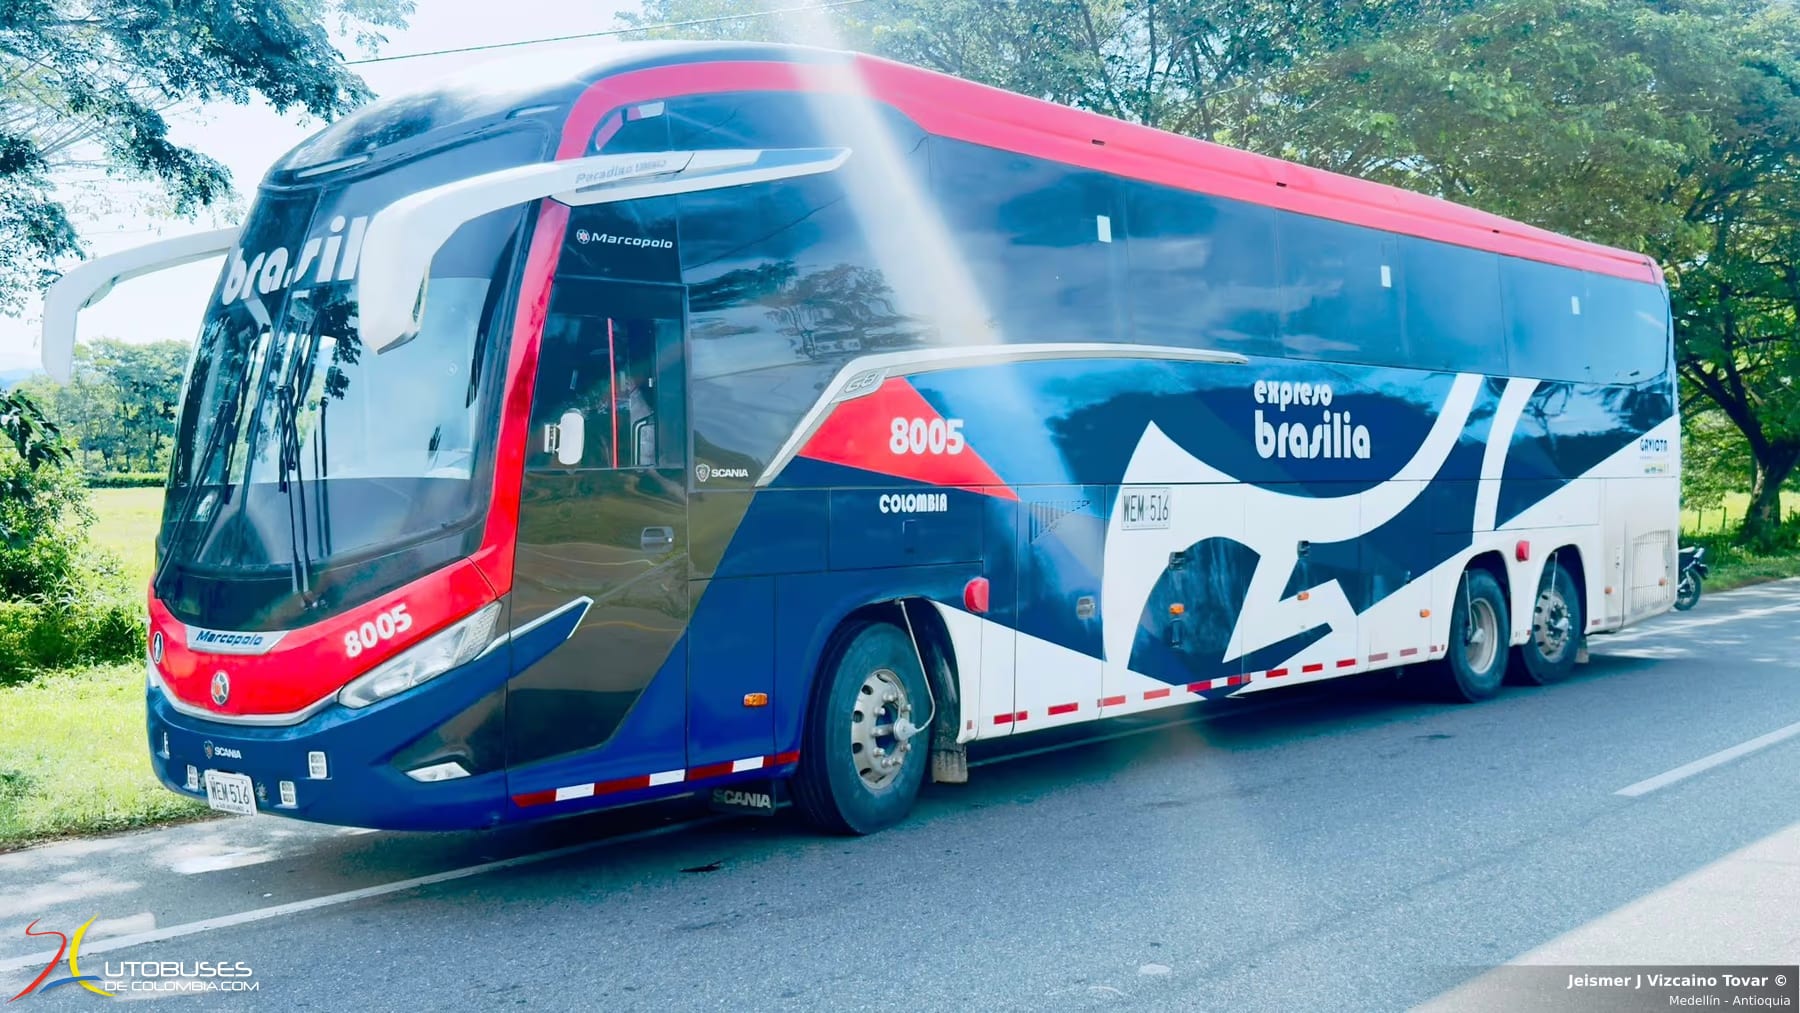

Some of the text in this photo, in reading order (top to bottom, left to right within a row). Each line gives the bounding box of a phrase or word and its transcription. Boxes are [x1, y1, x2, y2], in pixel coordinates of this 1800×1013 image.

[591, 232, 673, 249] Marcopolo
[1253, 379, 1333, 412] expreso
[889, 416, 964, 455] 8005
[1254, 409, 1371, 459] brasilia
[711, 468, 749, 478] SCANIA
[879, 493, 948, 514] COLOMBIA
[1123, 494, 1169, 522] WEM 516
[195, 629, 265, 647] Marcopolo
[344, 604, 412, 658] 8005
[214, 746, 242, 760] SCANIA
[209, 780, 250, 805] WEM 516
[712, 789, 772, 809] SCANIA
